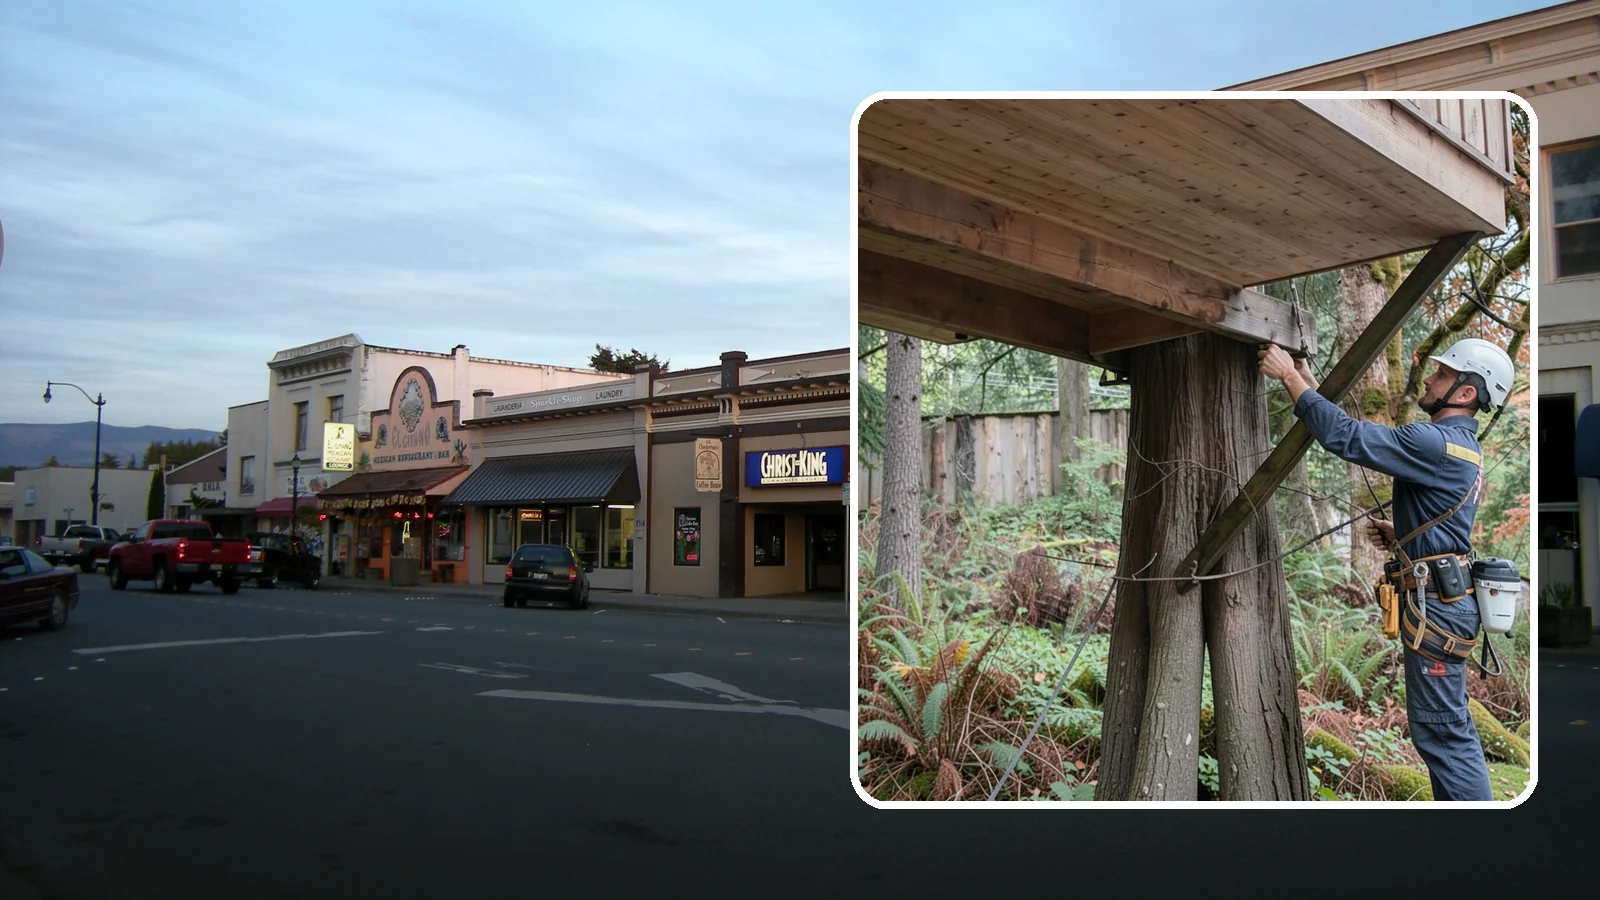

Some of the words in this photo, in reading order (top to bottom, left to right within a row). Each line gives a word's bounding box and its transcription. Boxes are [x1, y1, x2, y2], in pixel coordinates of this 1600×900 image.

[530, 397, 561, 409] Sparkle
[562, 394, 582, 405] Shop
[595, 389, 624, 400] LAUNDRY
[493, 402, 523, 412] LAVANDERIA
[374, 455, 396, 464] MEXICAN
[397, 451, 434, 462] RESTAURANT
[437, 450, 450, 459] BAR
[799, 449, 827, 476] KING
